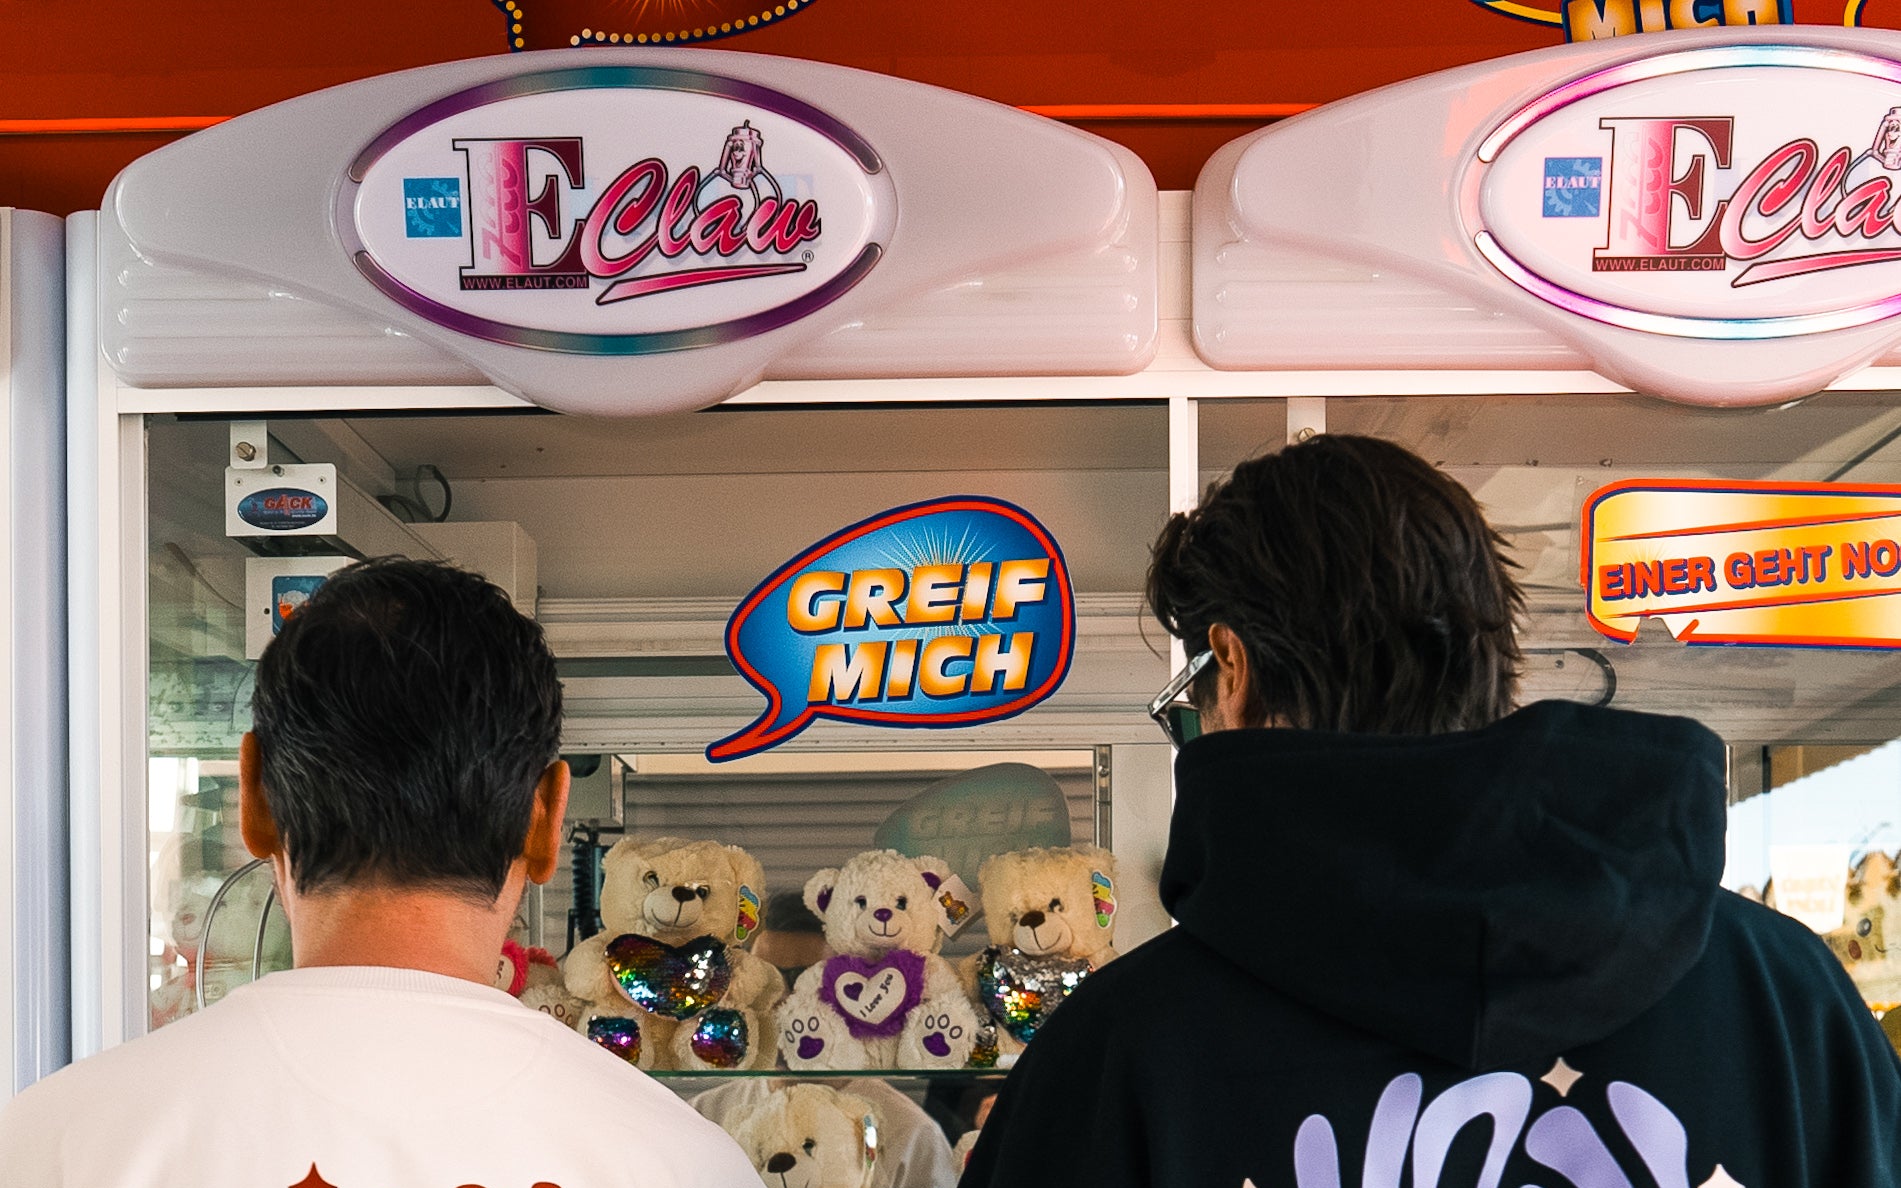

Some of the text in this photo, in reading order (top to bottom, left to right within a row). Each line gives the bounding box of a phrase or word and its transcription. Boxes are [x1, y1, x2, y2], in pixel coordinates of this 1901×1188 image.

[1546, 176, 1601, 189] ELAUT
[406, 196, 460, 210] ELAUT
[1595, 258, 1725, 271] WWW.ELAUT.COM
[463, 277, 588, 289] WWW.ELAUT.COM
[1598, 555, 1717, 601] EINER
[1724, 544, 1832, 590] GEHT
[787, 558, 1050, 635] GREIF
[807, 632, 1037, 703] MICH
